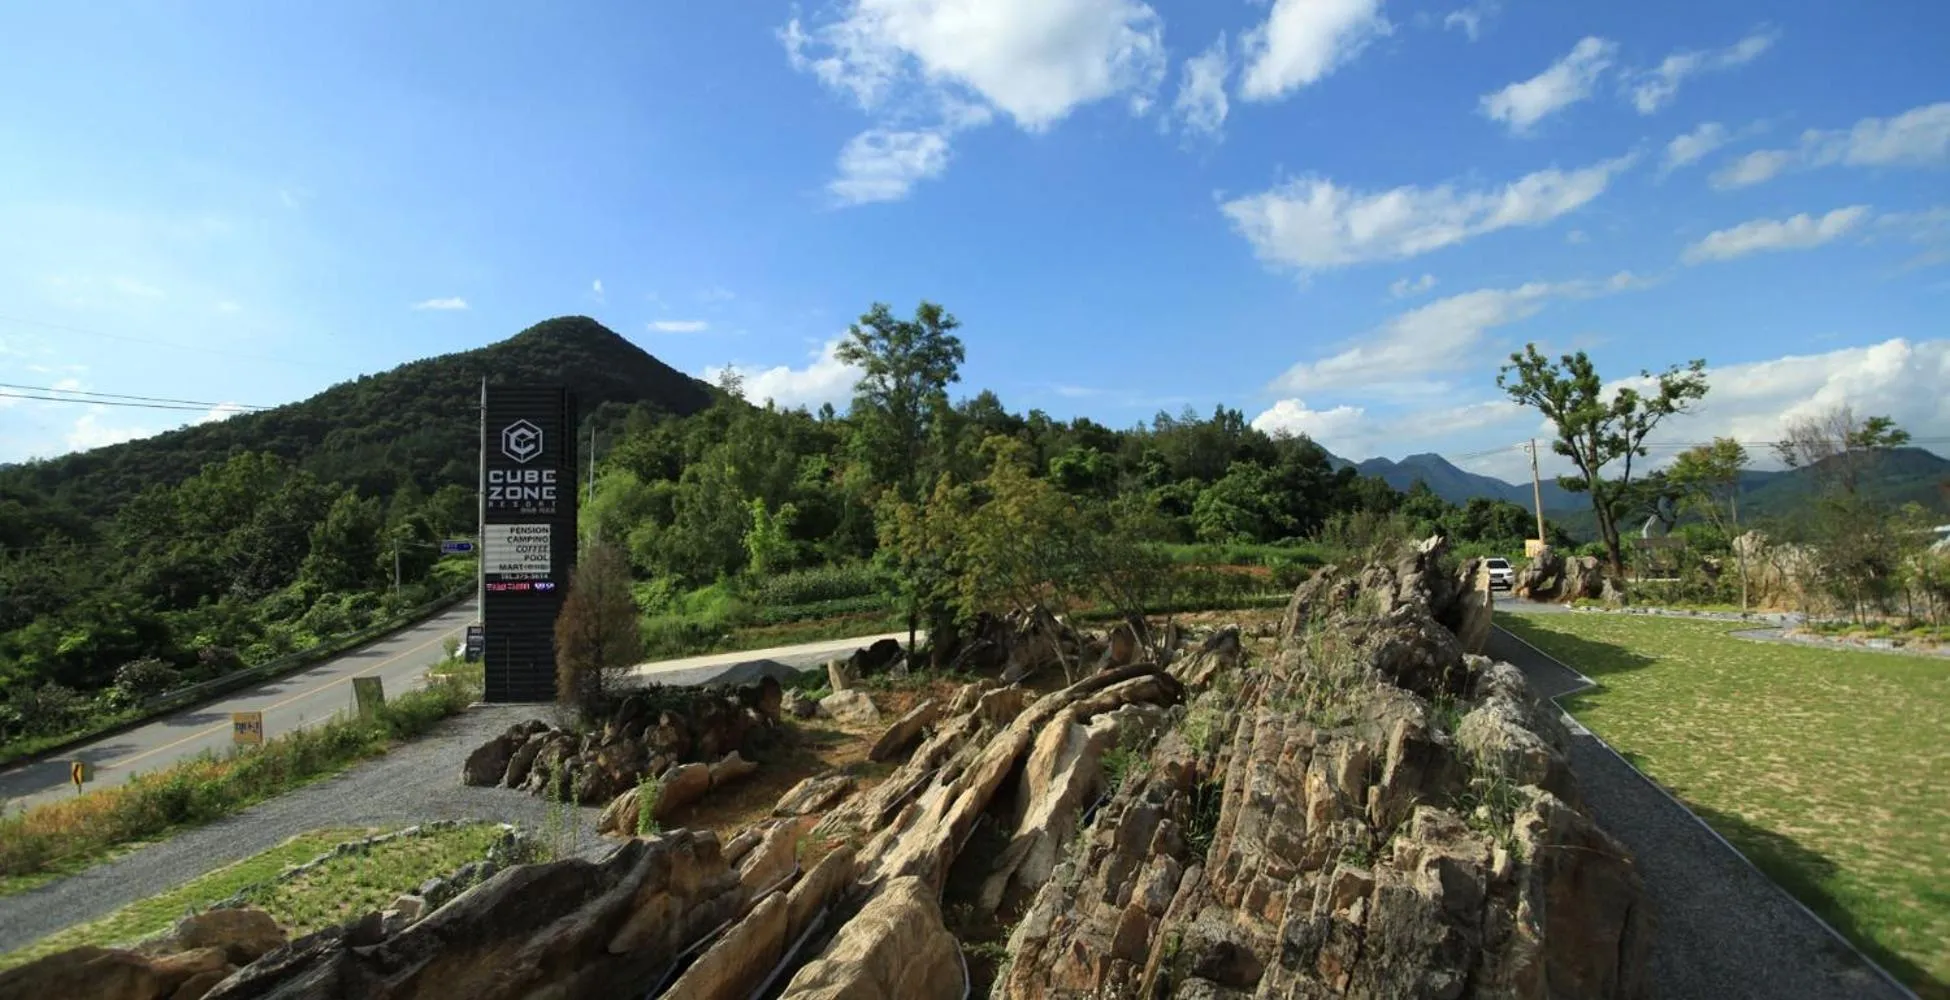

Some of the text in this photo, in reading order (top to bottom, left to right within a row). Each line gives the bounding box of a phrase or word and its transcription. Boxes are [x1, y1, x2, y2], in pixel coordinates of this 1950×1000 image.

[489, 470, 556, 483] CUBE
[489, 487, 556, 499] ZONE
[516, 545, 548, 553] COFFEE
